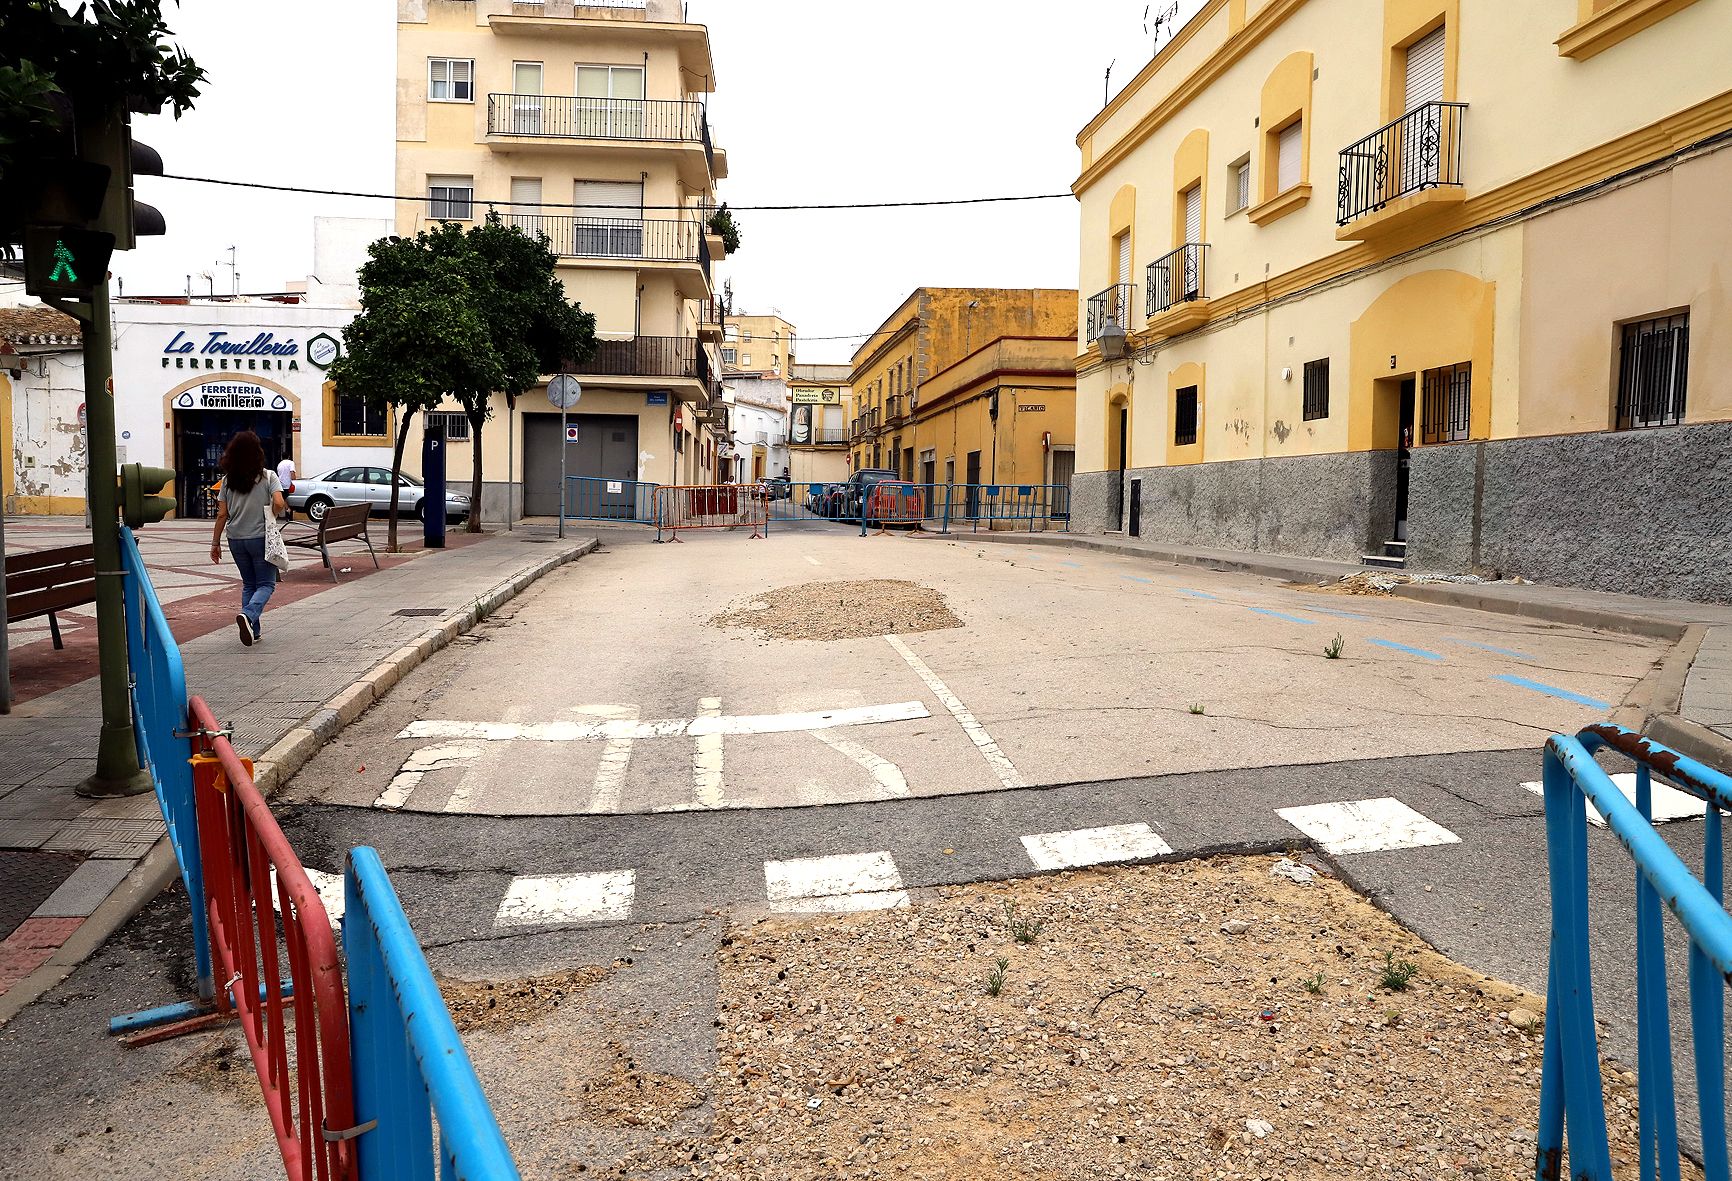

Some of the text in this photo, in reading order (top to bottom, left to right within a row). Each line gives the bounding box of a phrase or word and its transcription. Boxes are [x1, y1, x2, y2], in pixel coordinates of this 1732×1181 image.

[163, 330, 194, 354] La
[200, 331, 299, 356] Tornillería
[161, 357, 299, 371] FERRETERIA
[201, 385, 262, 394] FERRETERIA
[431, 440, 439, 450] P
